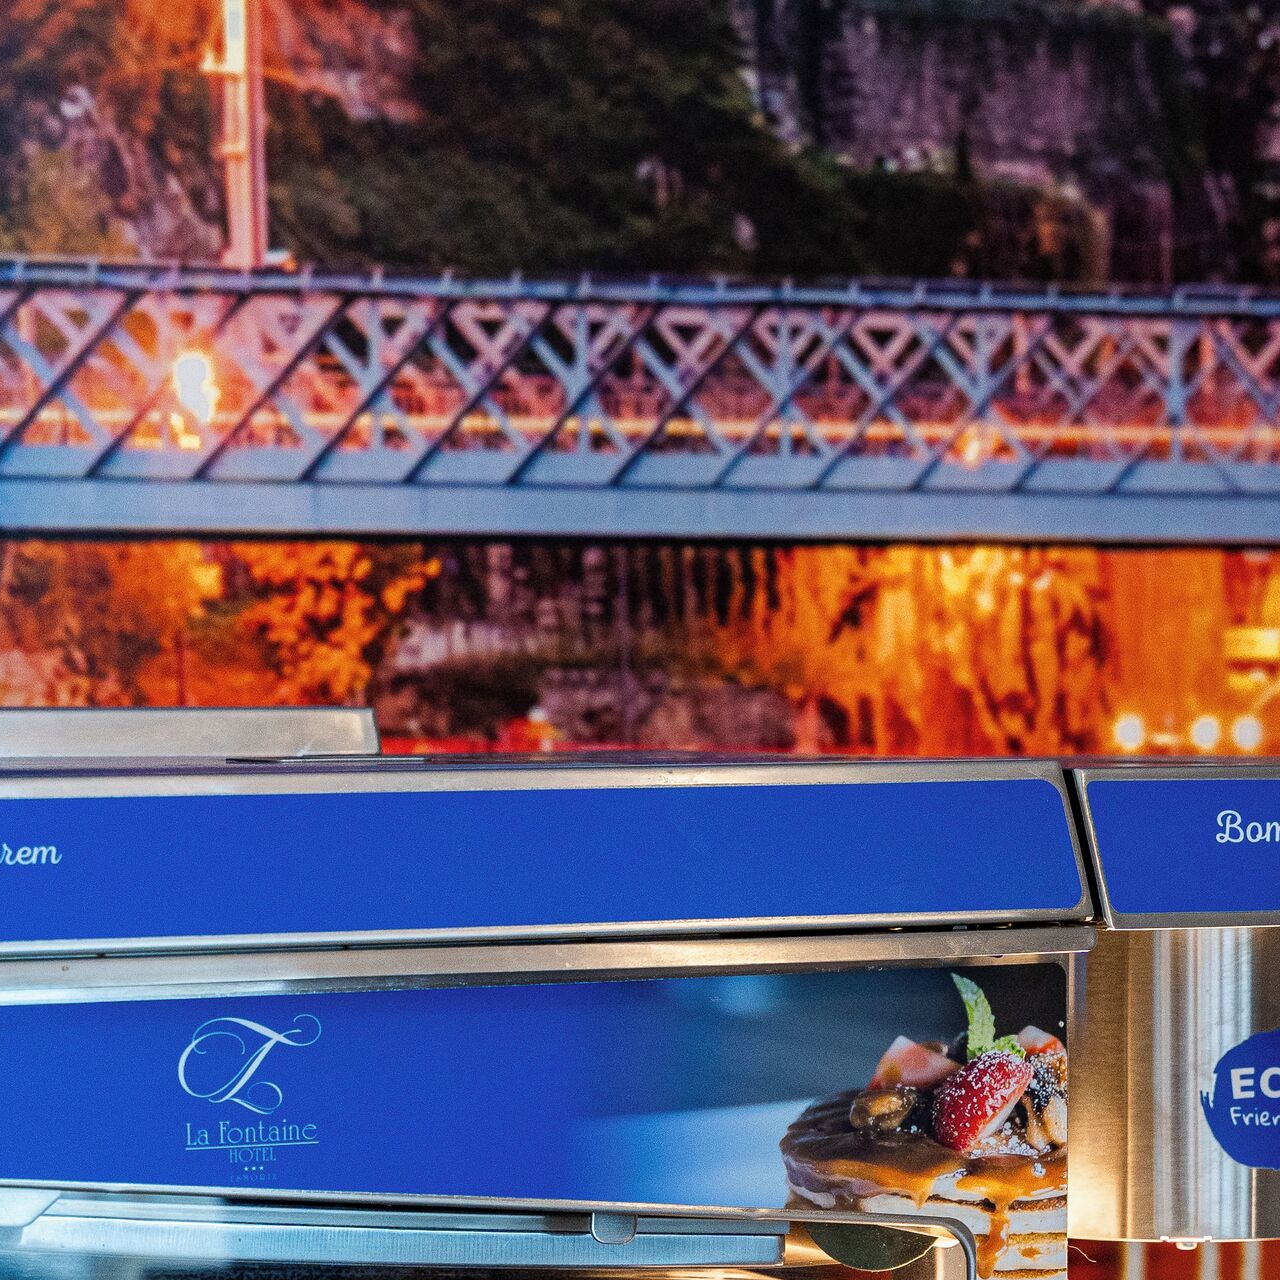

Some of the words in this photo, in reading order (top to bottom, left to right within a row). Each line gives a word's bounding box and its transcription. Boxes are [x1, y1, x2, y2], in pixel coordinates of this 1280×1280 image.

[185, 1123, 209, 1145] La
[219, 1119, 318, 1143] Fontaine
[229, 1148, 277, 1162] HOTEL
